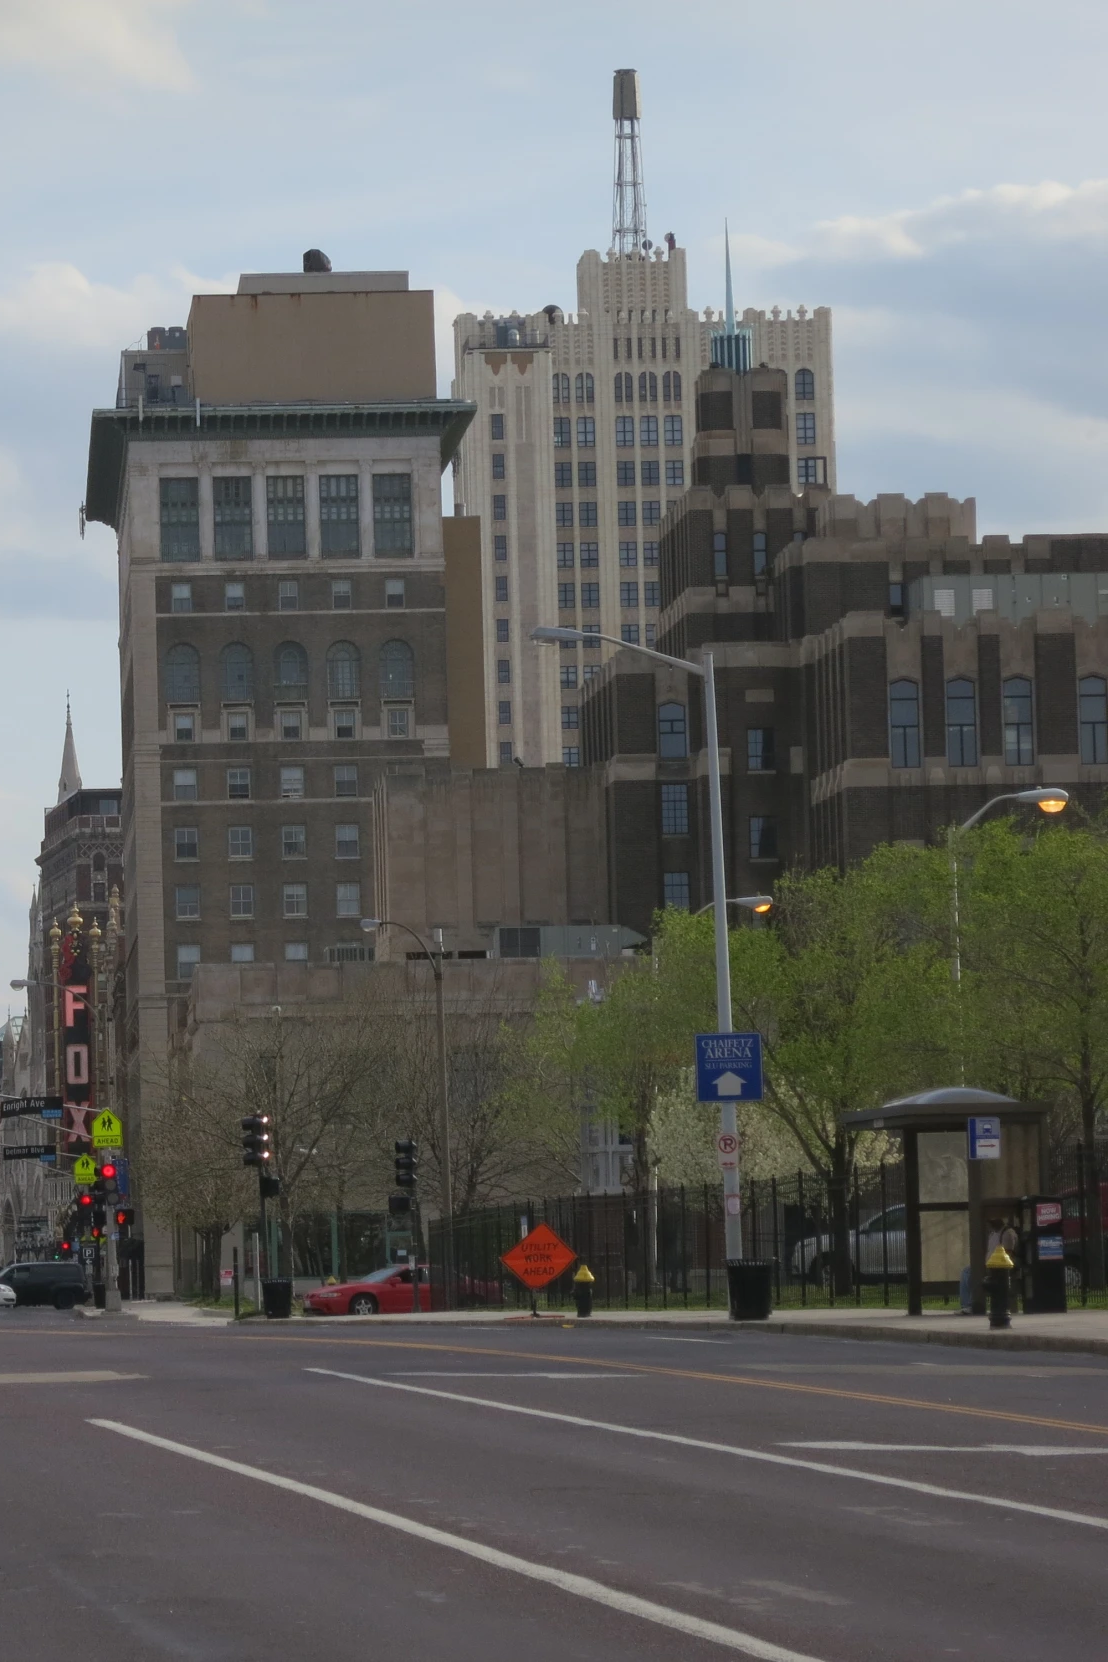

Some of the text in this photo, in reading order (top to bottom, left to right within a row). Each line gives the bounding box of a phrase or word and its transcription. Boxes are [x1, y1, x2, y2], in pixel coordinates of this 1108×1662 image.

[702, 1038, 754, 1048] CHAIFETZ
[704, 1047, 752, 1058] ARENA
[65, 985, 90, 1142] FOX
[719, 1061, 752, 1069] PARKING
[3, 1099, 45, 1112] Enright Ave
[5, 1148, 28, 1156] Delmar
[1041, 1207, 1057, 1215] NOW
[1038, 1213, 1060, 1221] HIRING
[521, 1243, 559, 1253] UTILITY
[524, 1254, 552, 1263] WORK
[523, 1266, 555, 1276] AHEAD
